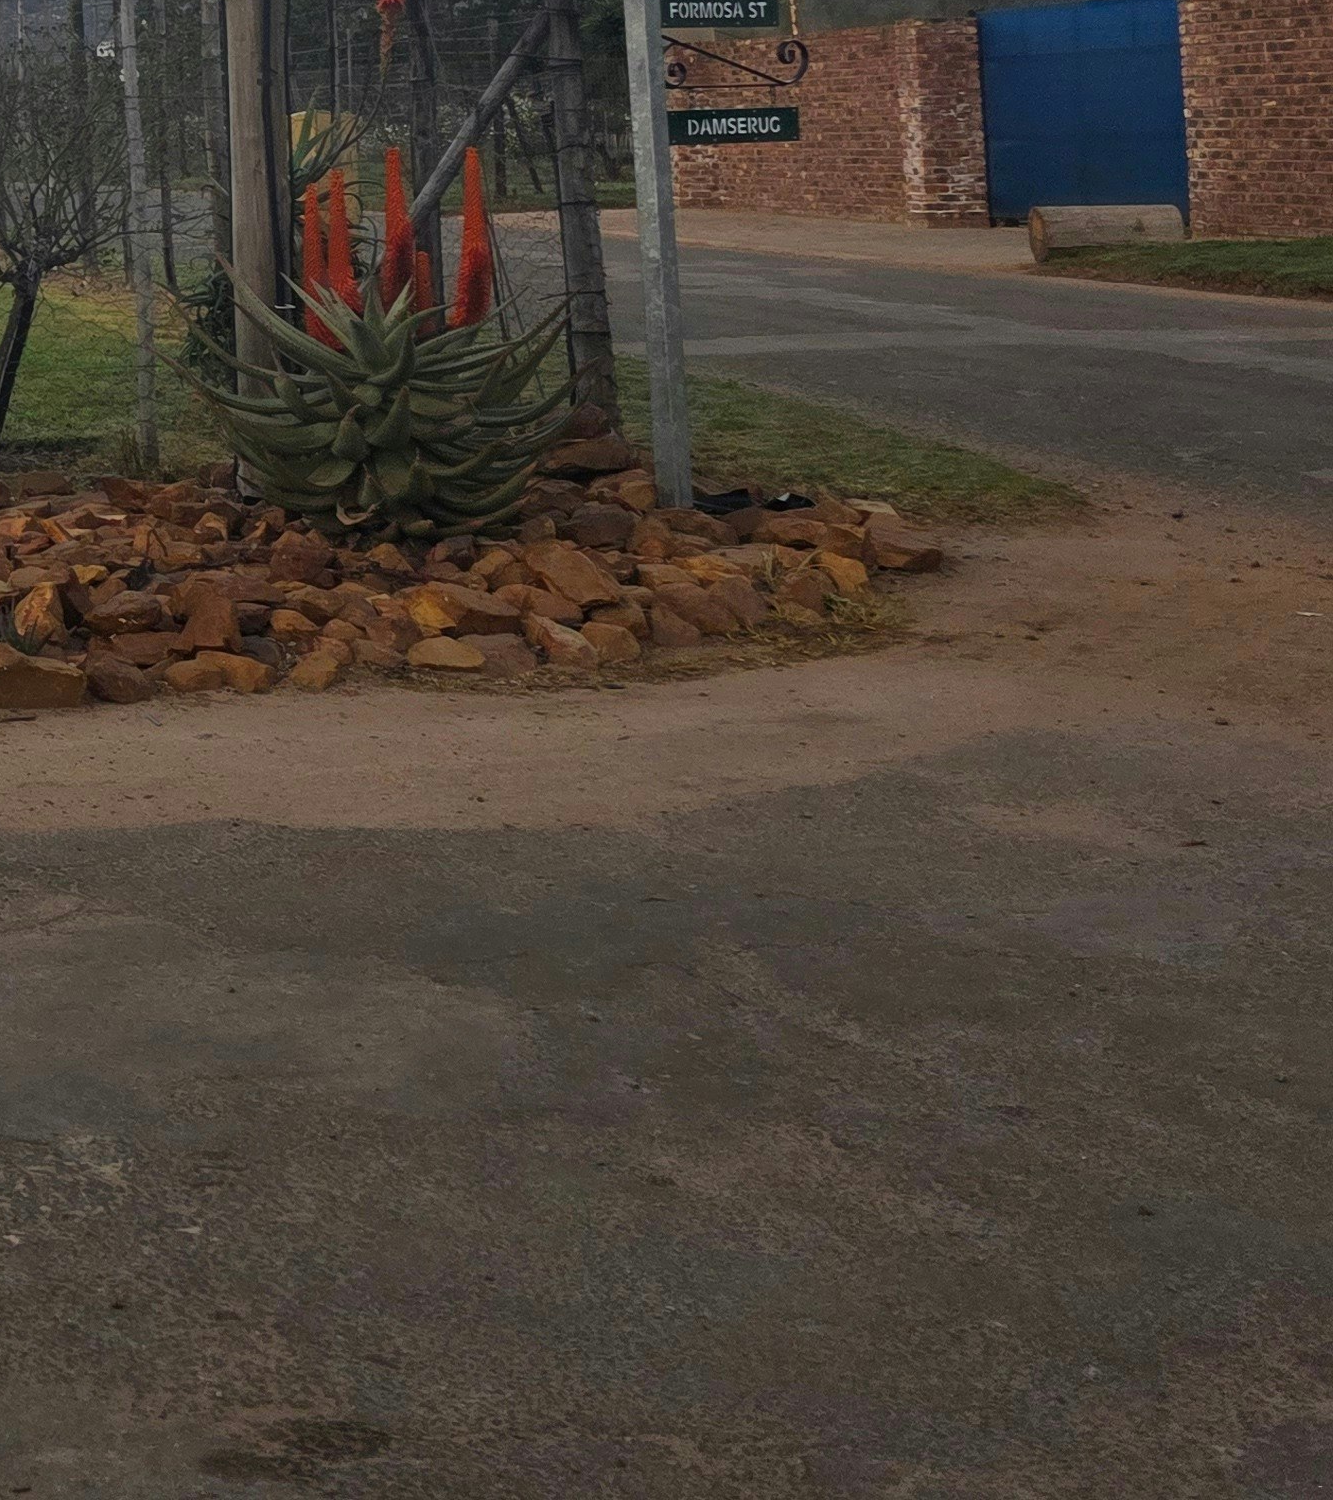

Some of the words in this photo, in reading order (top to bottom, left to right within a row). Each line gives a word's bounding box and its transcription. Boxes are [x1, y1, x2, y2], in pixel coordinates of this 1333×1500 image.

[669, 2, 744, 19] FORMOSA
[749, 1, 767, 18] ST
[687, 116, 782, 136] DAMSERUG
